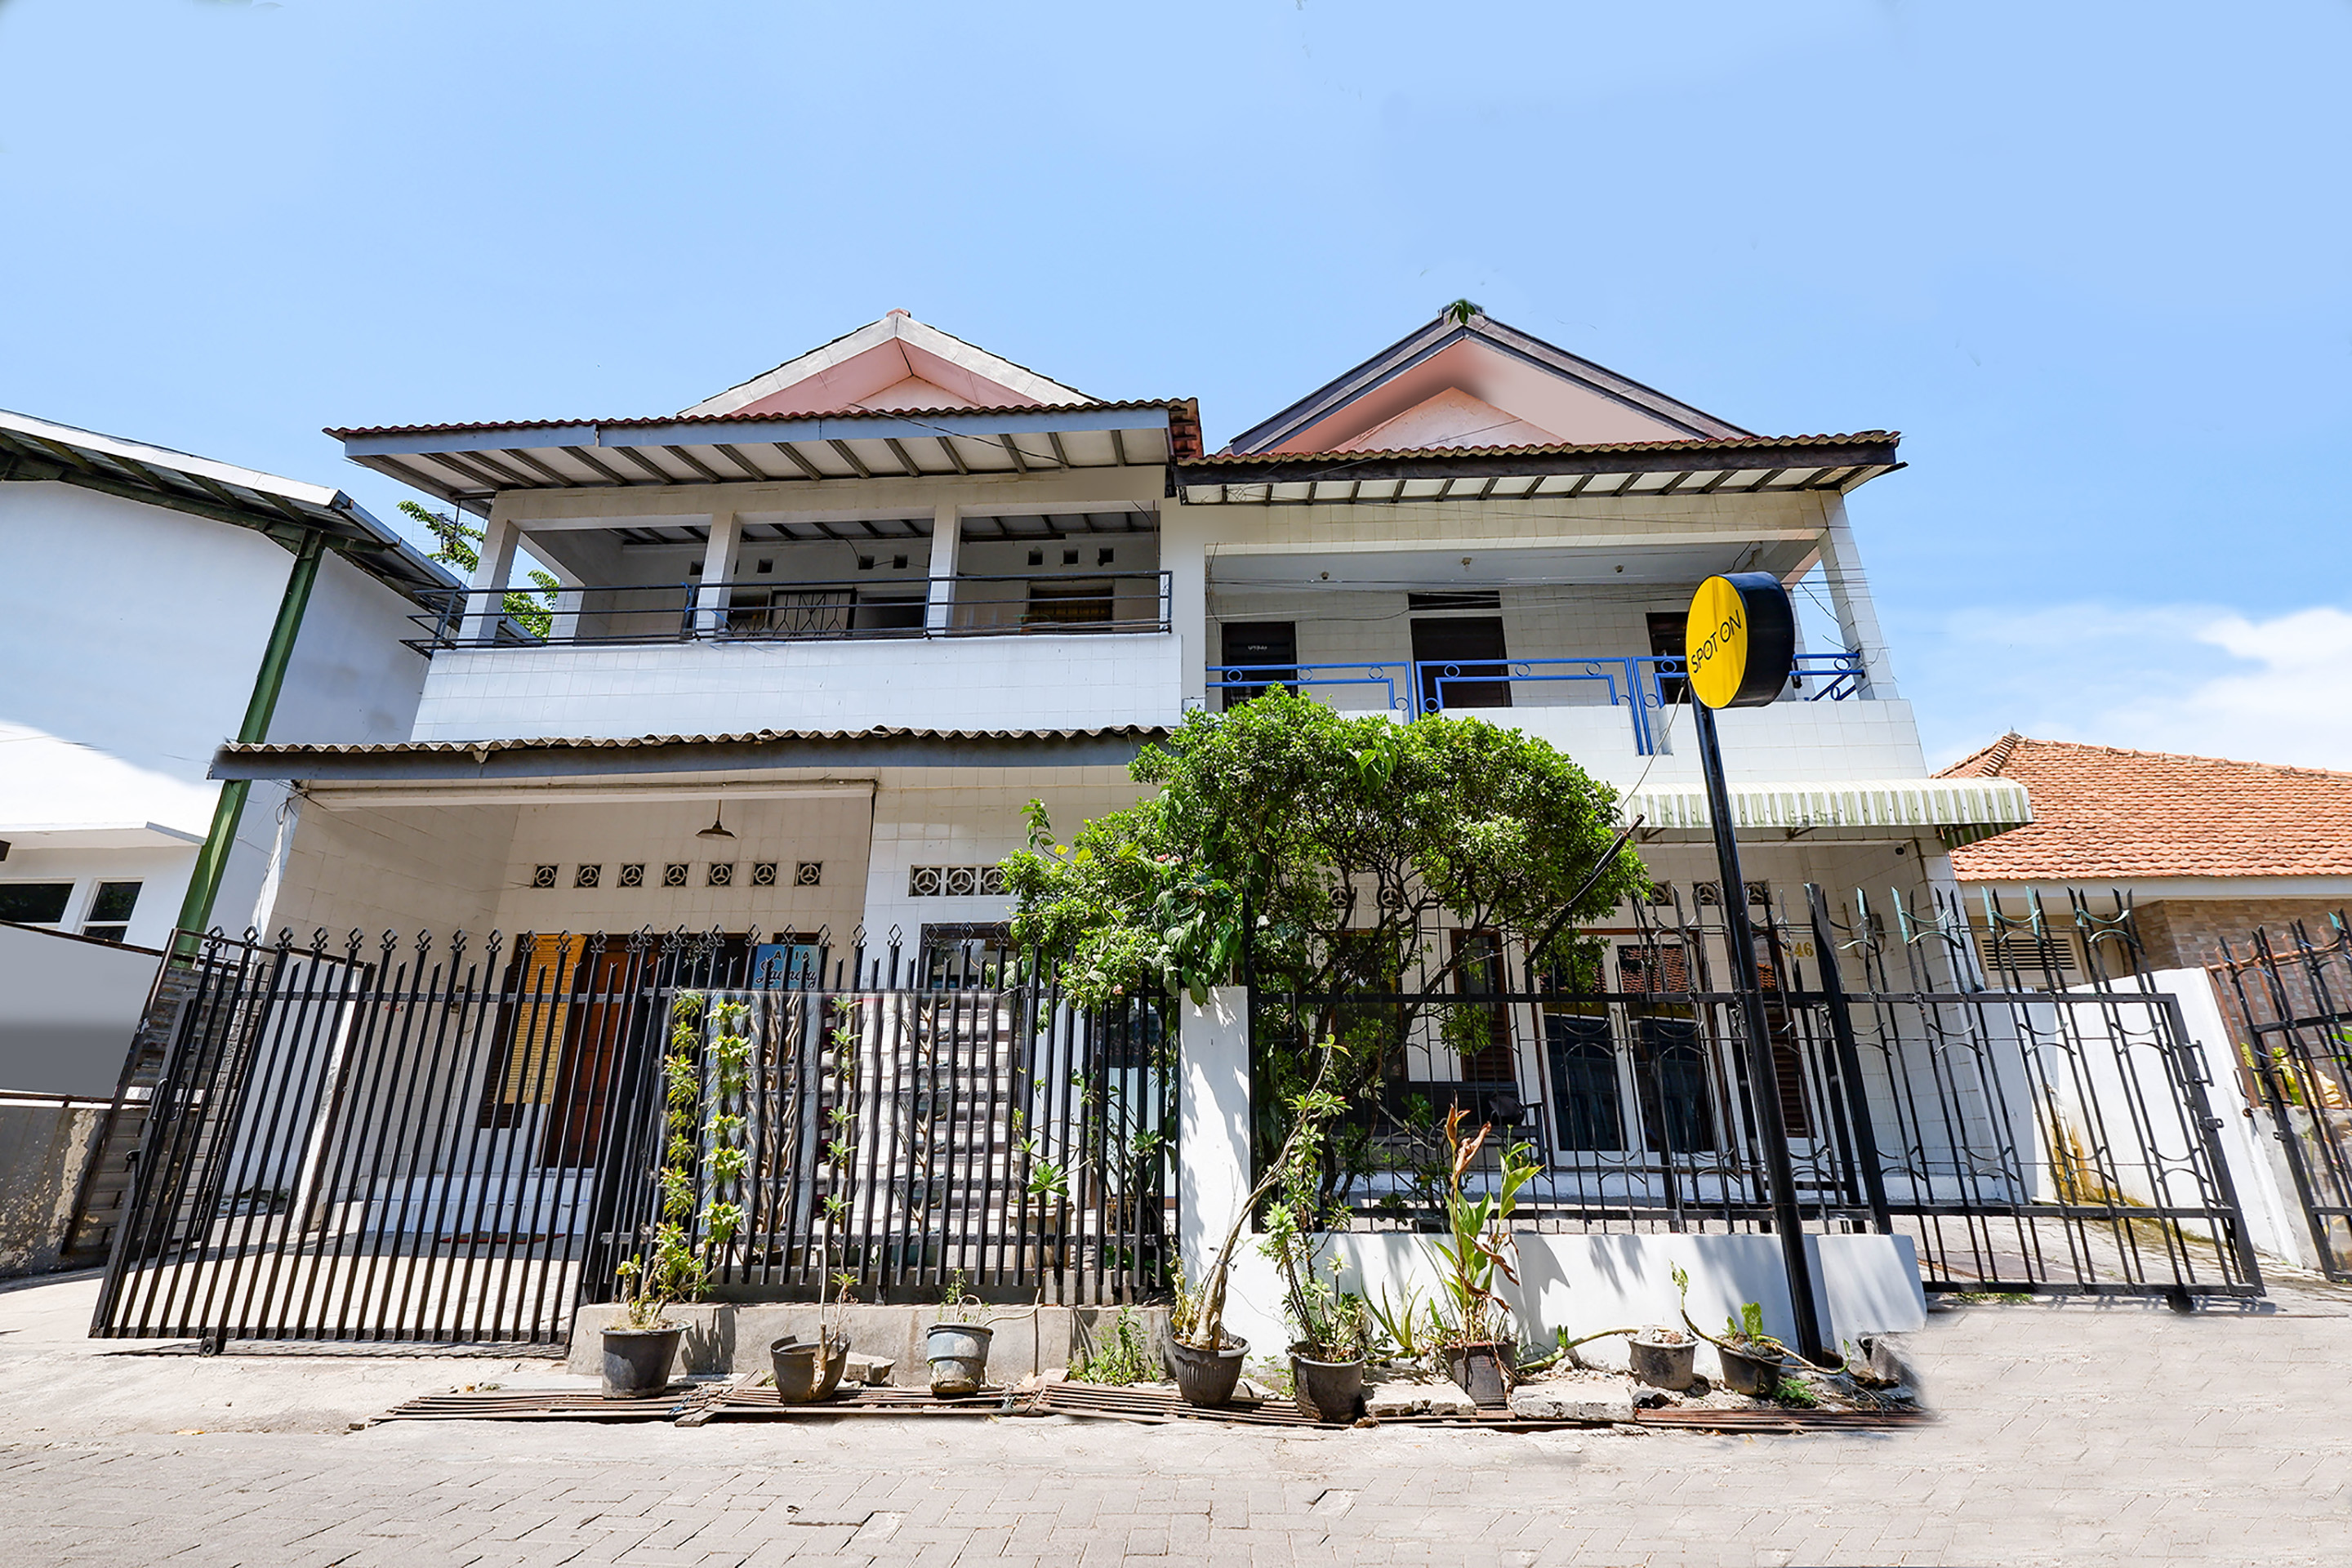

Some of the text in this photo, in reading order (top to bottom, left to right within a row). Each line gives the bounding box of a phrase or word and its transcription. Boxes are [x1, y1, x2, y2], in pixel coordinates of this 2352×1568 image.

[1690, 609, 1741, 674] SPOT ON
[773, 951, 809, 960] AIA
[1784, 942, 1814, 957] 46
